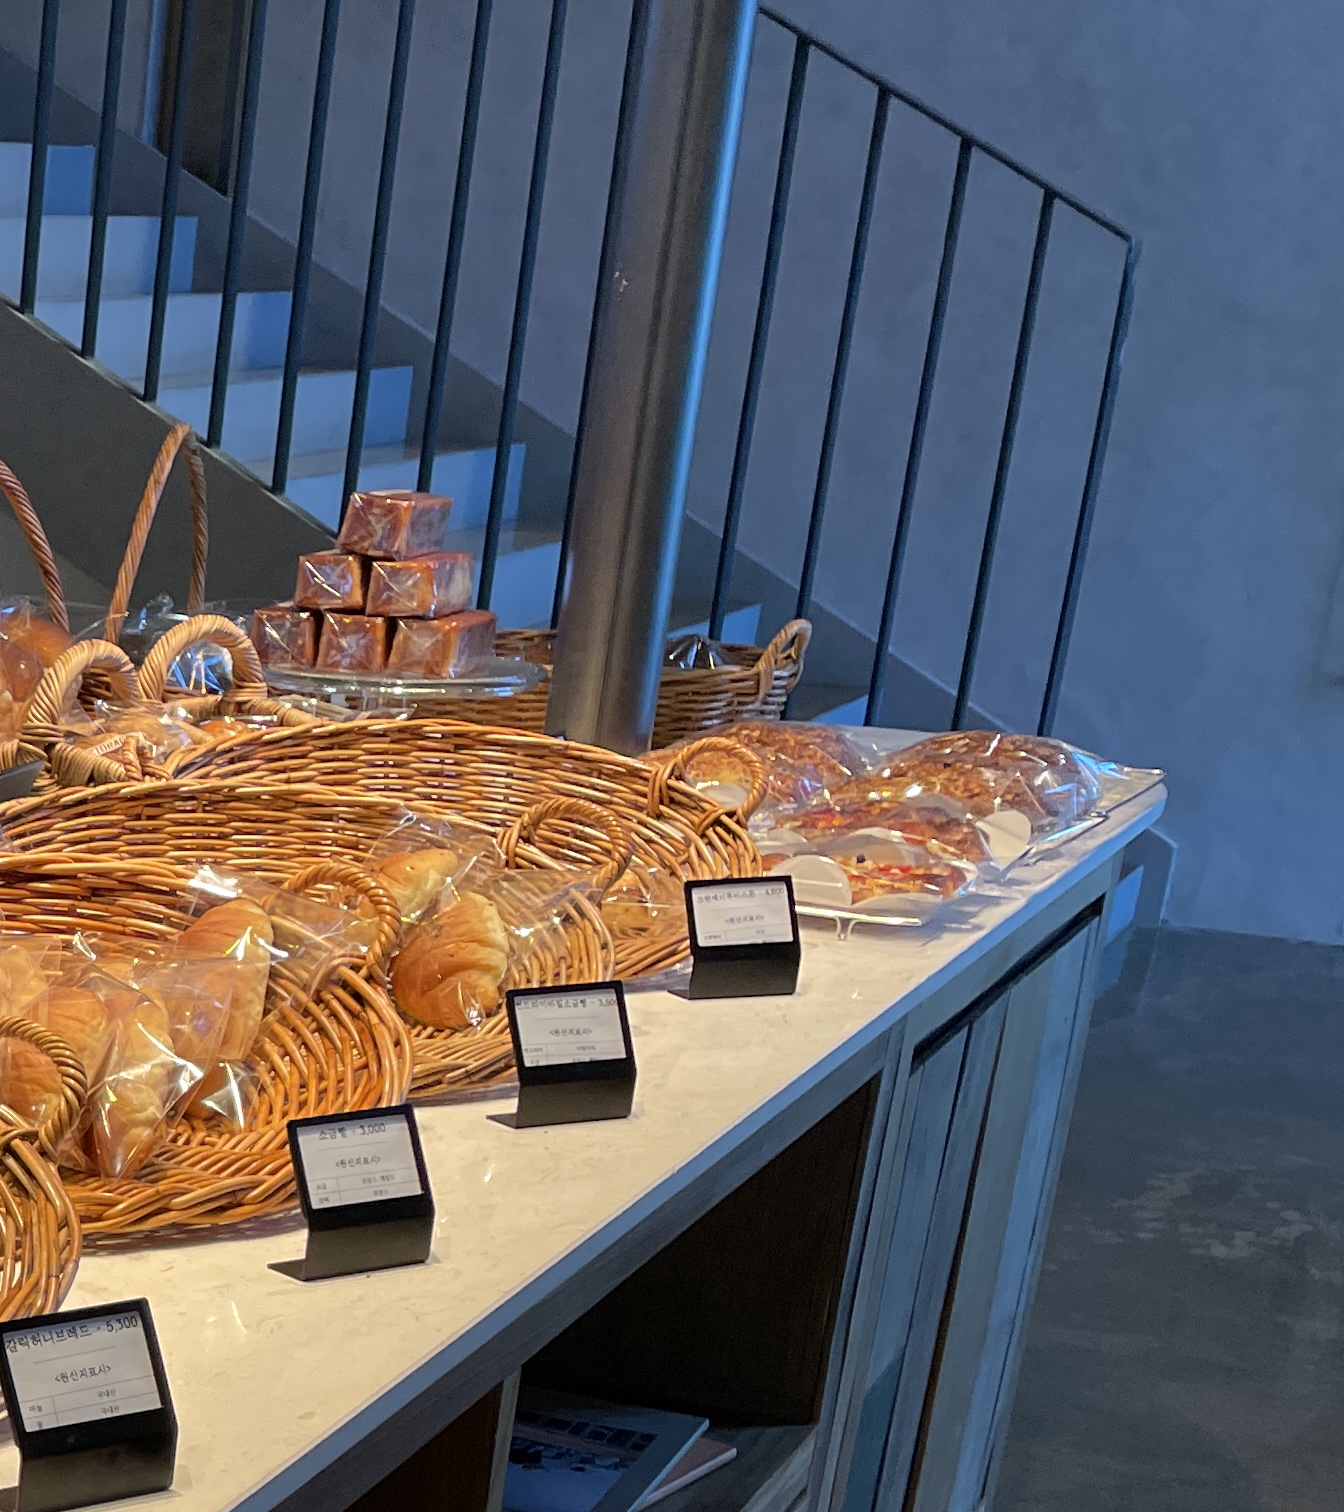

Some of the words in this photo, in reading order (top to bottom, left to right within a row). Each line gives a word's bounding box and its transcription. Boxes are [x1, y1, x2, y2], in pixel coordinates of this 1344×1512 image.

[319, 1127, 347, 1140] 소금빵
[5, 1324, 93, 1354] 갈릭허니브레드
[105, 1315, 139, 1334] 5,300
[54, 1363, 112, 1384] <원산지표시>
